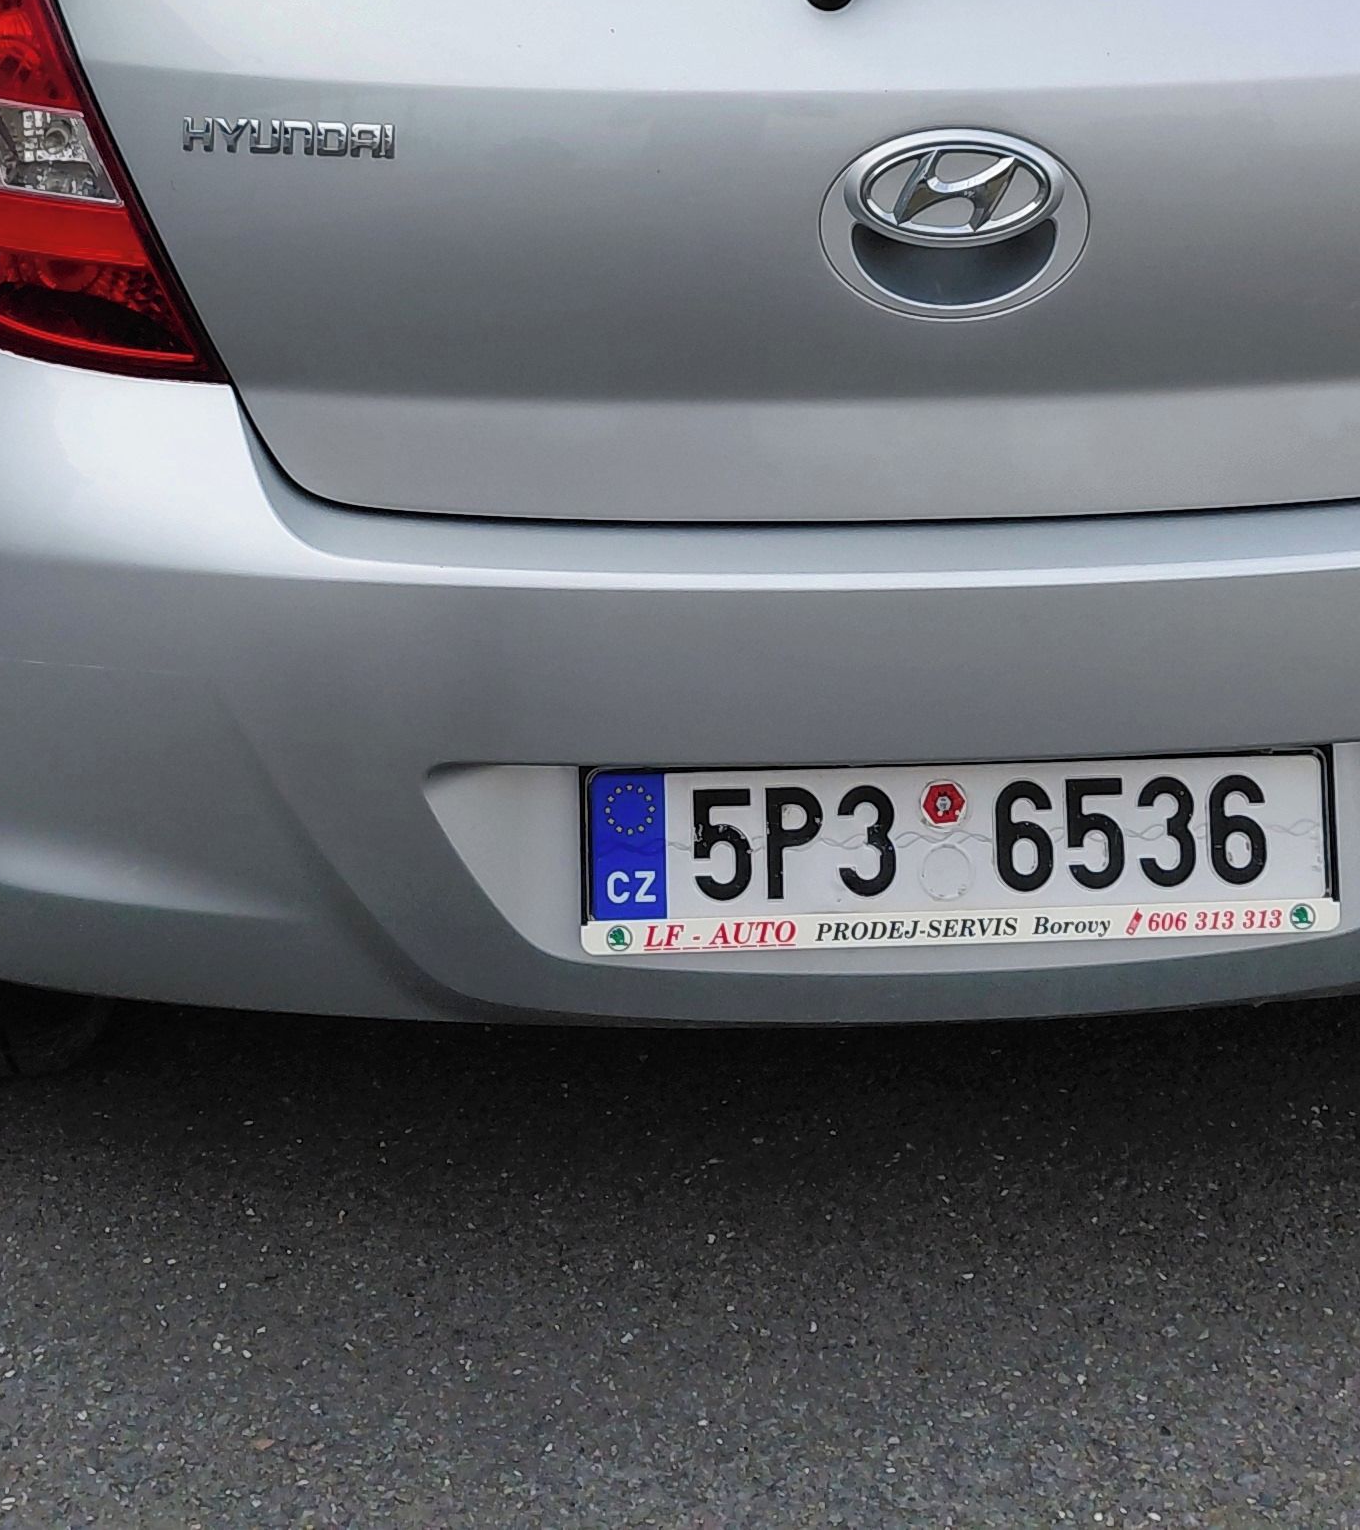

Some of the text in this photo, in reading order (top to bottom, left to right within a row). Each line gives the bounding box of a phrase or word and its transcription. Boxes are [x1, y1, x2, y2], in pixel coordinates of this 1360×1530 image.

[182, 116, 396, 159] HYUNDAI
[693, 774, 1267, 901] 5P3 6536
[606, 870, 658, 904] CZ
[709, 920, 797, 946] AUTO
[814, 916, 1019, 942] PRODEJ-SERVIS
[1031, 916, 1112, 936] Borovy
[1147, 911, 1188, 932] 606
[1194, 910, 1236, 930] 313
[1242, 909, 1283, 929] 313
